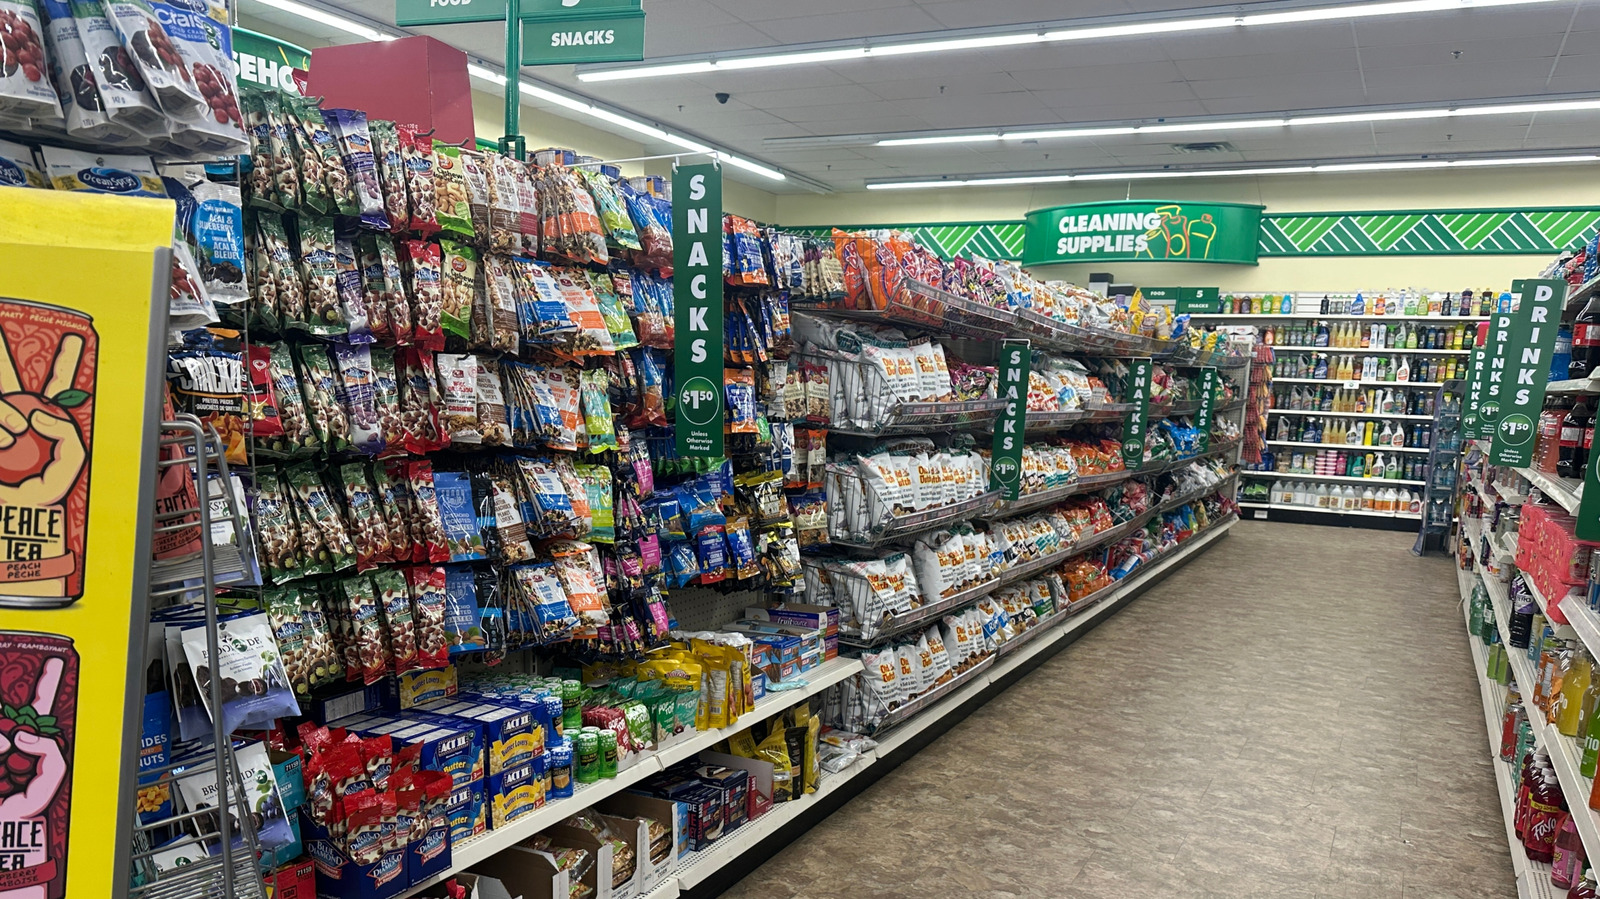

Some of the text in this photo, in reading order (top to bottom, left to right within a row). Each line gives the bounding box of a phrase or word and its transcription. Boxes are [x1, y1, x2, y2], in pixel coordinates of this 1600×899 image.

[551, 30, 615, 47] SNACKS
[83, 173, 111, 186] Ocean
[1058, 212, 1162, 234] CLEANING
[1056, 233, 1149, 255] SUPPLIES
[687, 174, 709, 363] SNACKS
[1196, 290, 1204, 298] 5
[0, 310, 25, 320] PARTY
[55, 319, 88, 332] MIGNON
[1488, 316, 1511, 396] DRINKS
[1514, 285, 1553, 406] DRINKS
[1470, 351, 1485, 410] DRINKS
[1003, 350, 1021, 450] SNACKS
[1130, 365, 1146, 435] SNACKS
[1198, 372, 1212, 427] SNACKS
[0, 505, 62, 538] EACE
[0, 535, 48, 561] TEA
[7, 562, 41, 572] PEACH
[777, 617, 808, 627] fruitsource
[17, 642, 69, 653] FRAMBOYANT
[440, 735, 467, 753] ACT II
[443, 761, 467, 774] Butter
[507, 770, 521, 782] ACT
[450, 816, 468, 828] utter
[0, 821, 44, 848] ACE
[420, 831, 446, 853] DIAMOND
[308, 843, 343, 866] DIAMOND
[316, 840, 335, 855] BLUE
[373, 854, 402, 878] DIAMOND
[381, 855, 395, 868] BLUE
[0, 868, 37, 880] PBERRY
[0, 875, 39, 888] MBOISE
